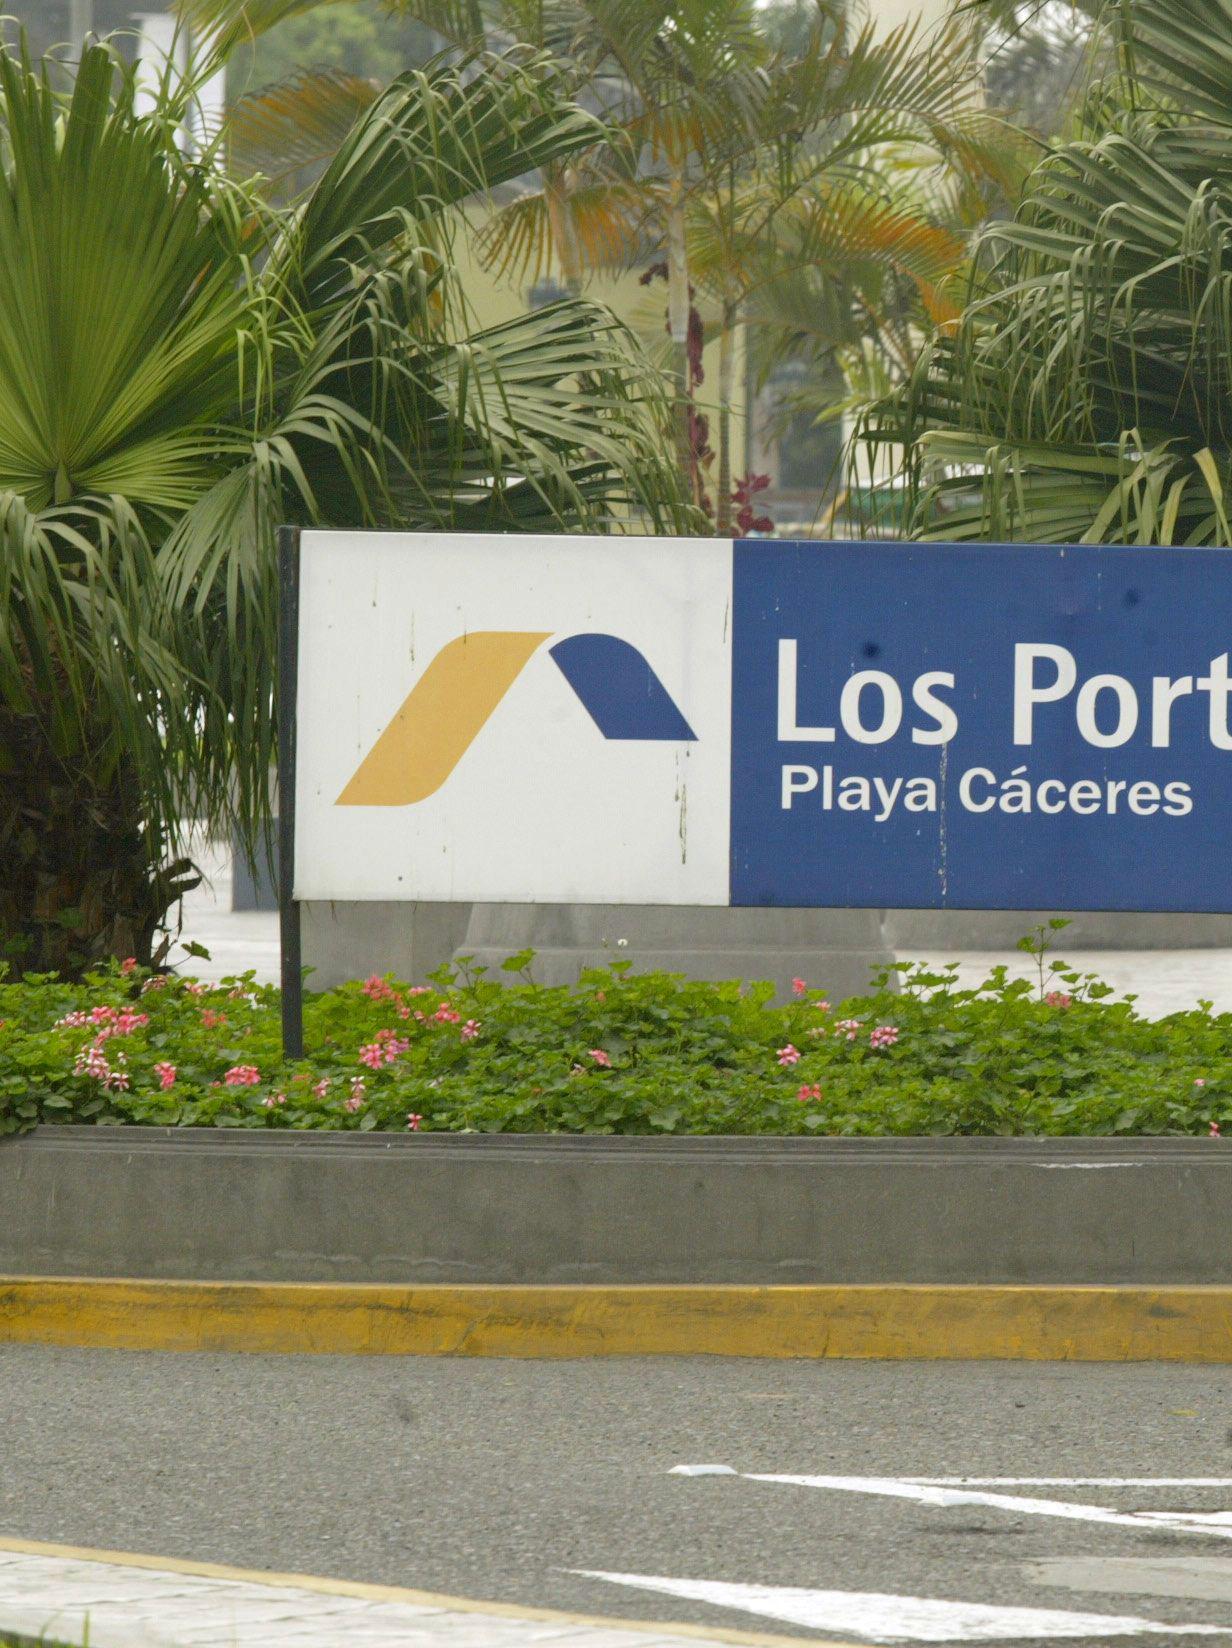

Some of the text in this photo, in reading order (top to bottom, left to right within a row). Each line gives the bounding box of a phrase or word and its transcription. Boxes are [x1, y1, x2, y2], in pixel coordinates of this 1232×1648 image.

[776, 637, 958, 746] Los
[781, 764, 1193, 822] Playa Cáceres
